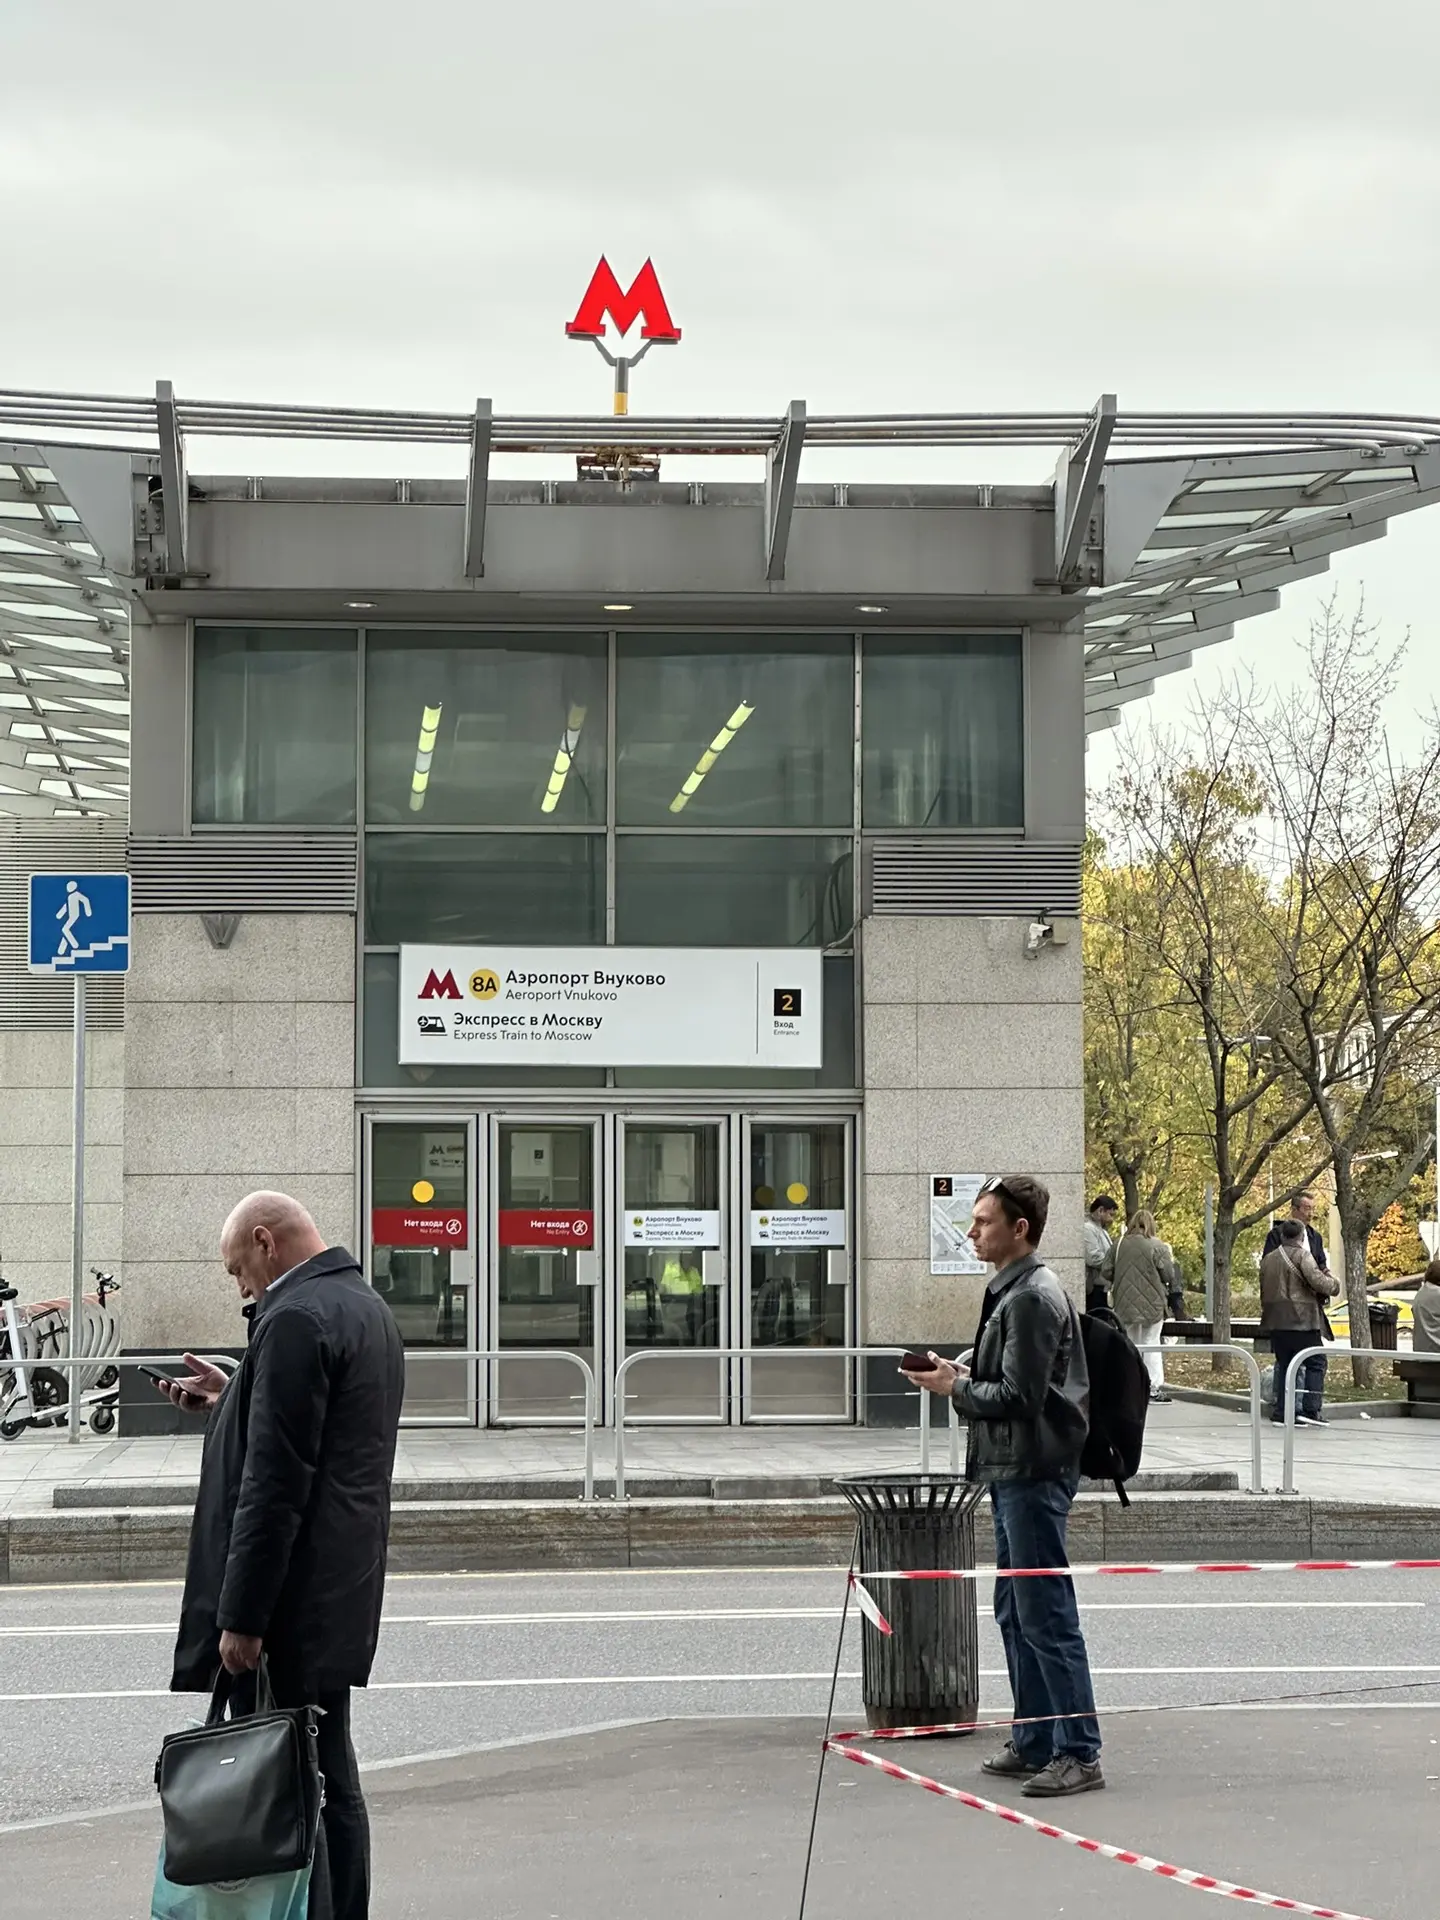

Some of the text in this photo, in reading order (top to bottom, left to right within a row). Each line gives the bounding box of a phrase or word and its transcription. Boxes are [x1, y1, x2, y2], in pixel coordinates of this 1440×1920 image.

[565, 253, 681, 341] М
[417, 968, 464, 999] М
[472, 976, 497, 992] 8А
[506, 970, 666, 988] Аэропорт Внуково
[506, 989, 618, 1002] Aeroport Vnukovo
[782, 994, 794, 1011] 2
[454, 1012, 603, 1029] Экспресс в Москву
[774, 1021, 794, 1029] Вход
[454, 1029, 593, 1042] Express Train to Moscow
[939, 1179, 948, 1191] 2
[404, 1219, 444, 1228] Нет входа
[530, 1220, 570, 1229] Нет входа
